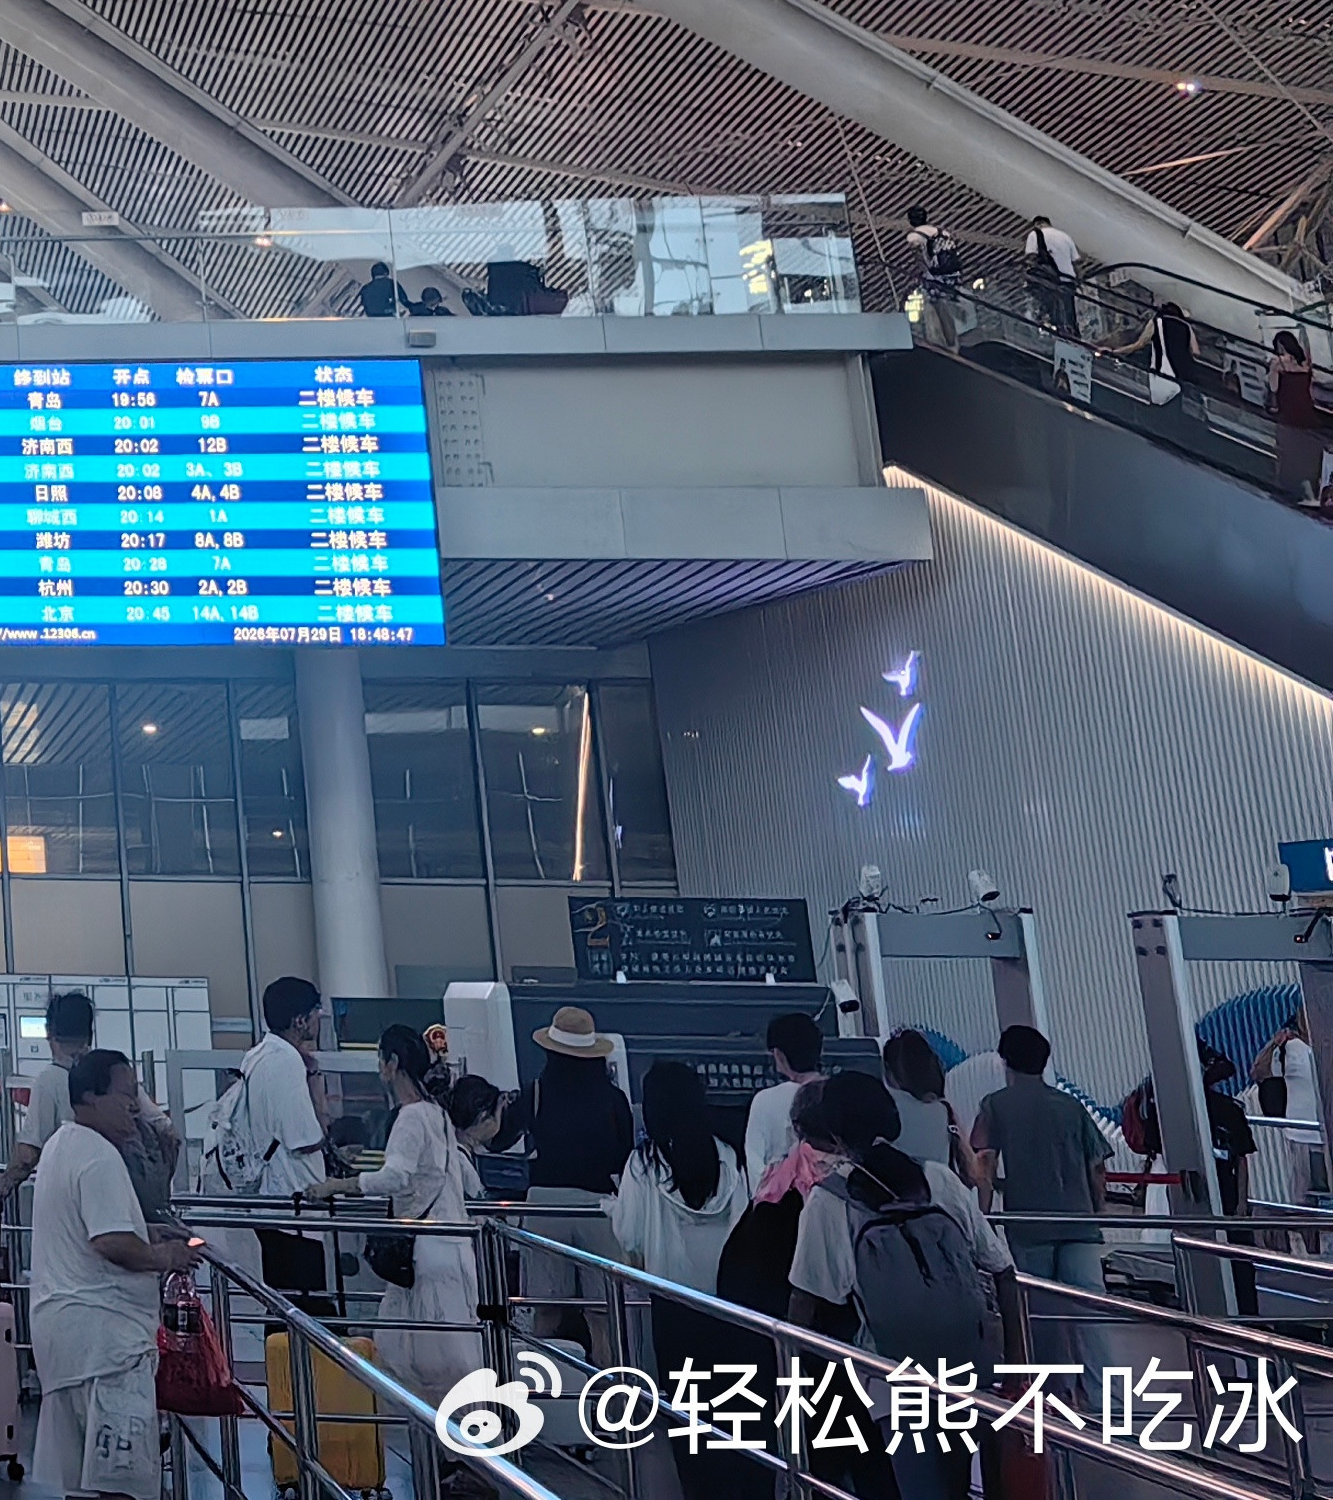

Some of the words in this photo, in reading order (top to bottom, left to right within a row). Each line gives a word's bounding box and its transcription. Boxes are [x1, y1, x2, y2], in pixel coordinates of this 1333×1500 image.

[14, 368, 71, 386] 终到站
[113, 368, 150, 385] 开点
[176, 368, 233, 385] 检票口
[315, 366, 353, 383] 状态
[27, 392, 62, 409] 青岛
[112, 392, 156, 407] 19:56
[199, 391, 220, 406] 7A
[299, 388, 374, 407] 二楼候车
[22, 438, 73, 455] 济南西
[115, 439, 158, 453] 20:02
[199, 437, 228, 453] 12B
[303, 434, 379, 453] 二楼候车
[36, 485, 68, 502] 日照
[118, 485, 162, 500] 20:08
[307, 482, 383, 501] 二楼候车
[36, 532, 70, 549] 潍坊
[121, 533, 165, 548] 20:17
[311, 530, 387, 549] 二楼候车
[38, 579, 73, 597] 杭州
[124, 581, 169, 595] 20:30
[315, 578, 391, 597] 二楼候车
[234, 627, 342, 643] 2026年07月29日
[351, 628, 413, 641] 18:48:47
